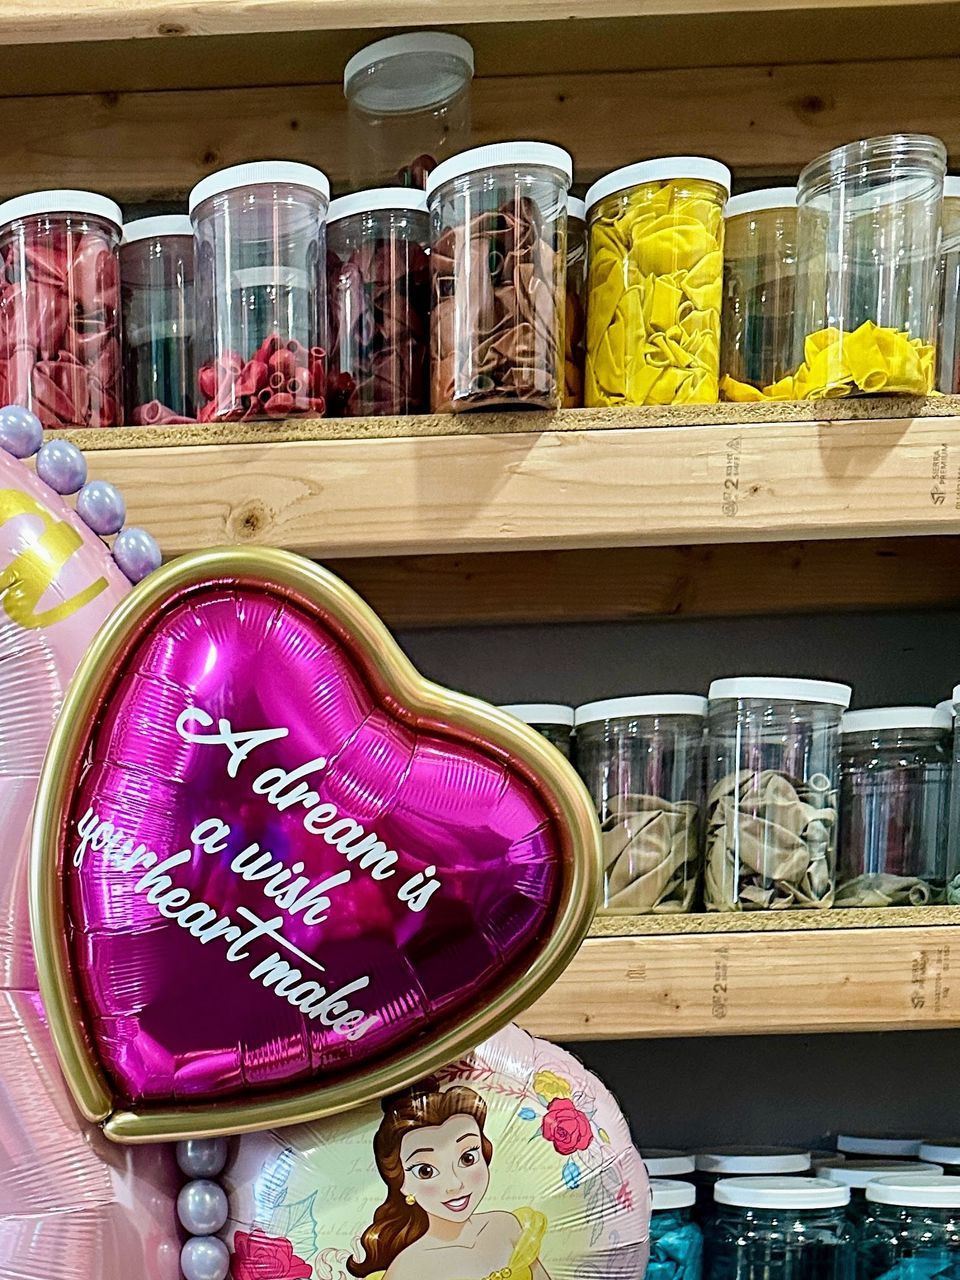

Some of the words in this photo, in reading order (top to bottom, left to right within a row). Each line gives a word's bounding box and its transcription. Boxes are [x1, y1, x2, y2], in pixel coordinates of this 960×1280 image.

[931, 450, 941, 480] SIERRA
[939, 442, 949, 485] PREMIUM
[176, 708, 289, 778] A
[252, 757, 399, 882] dream
[397, 865, 441, 912] is
[73, 806, 157, 874] your
[135, 849, 325, 971] heart
[249, 952, 382, 1041] makes
[190, 818, 229, 854] a
[230, 842, 351, 925] wish
